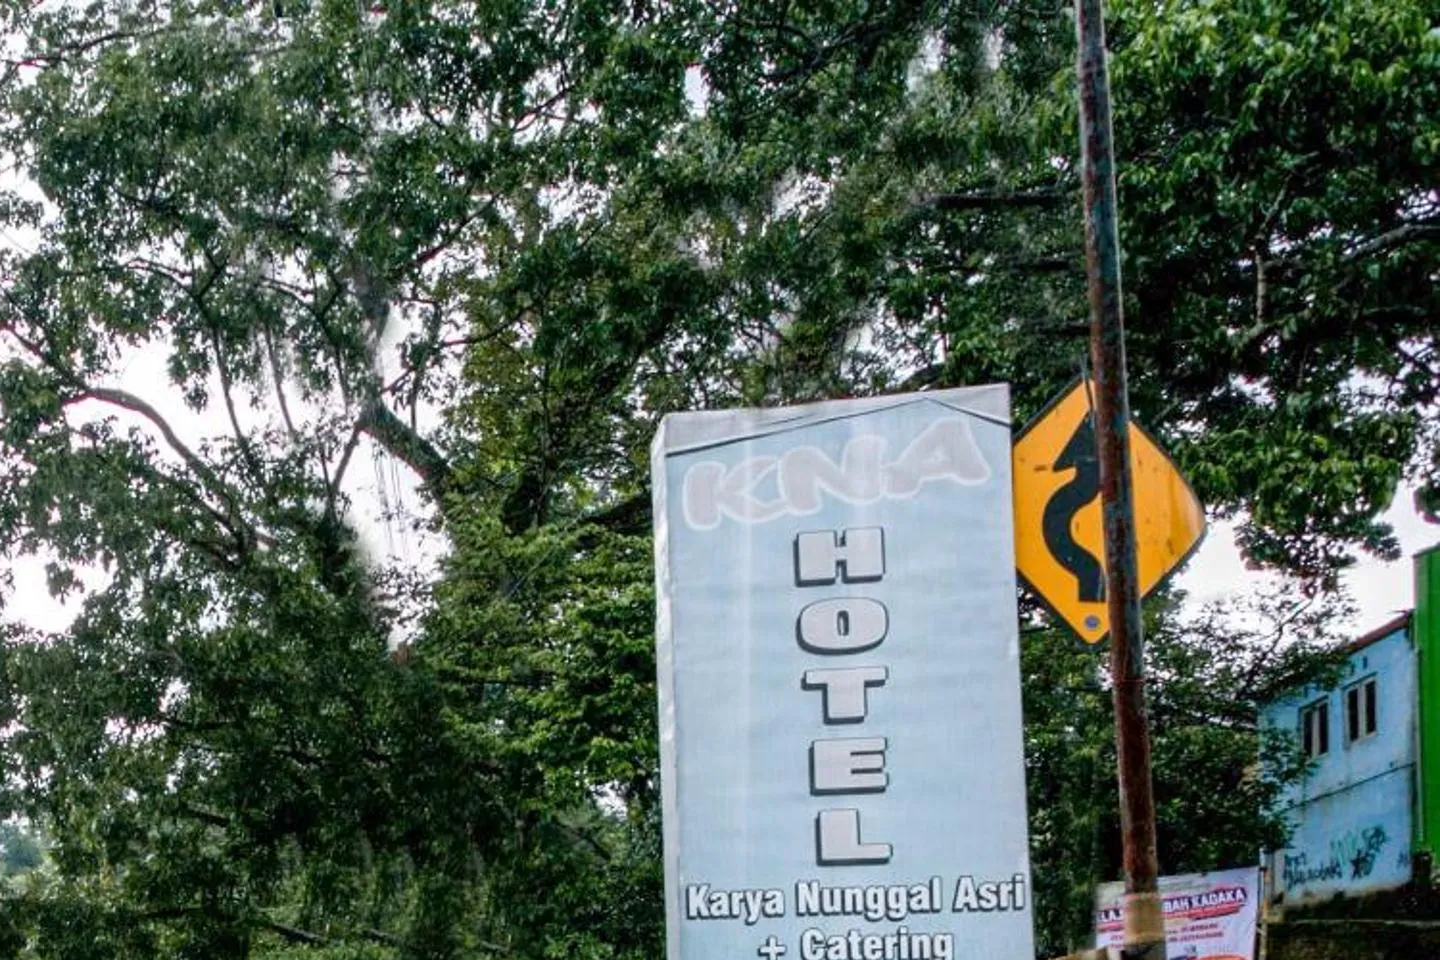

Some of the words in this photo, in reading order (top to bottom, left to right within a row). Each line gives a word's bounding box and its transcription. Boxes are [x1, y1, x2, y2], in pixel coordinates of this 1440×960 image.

[683, 417, 991, 531] KNA
[792, 525, 894, 867] HOTEL
[686, 882, 786, 925] Karya
[795, 876, 943, 922] Nunggal
[952, 873, 1026, 912] Asri
